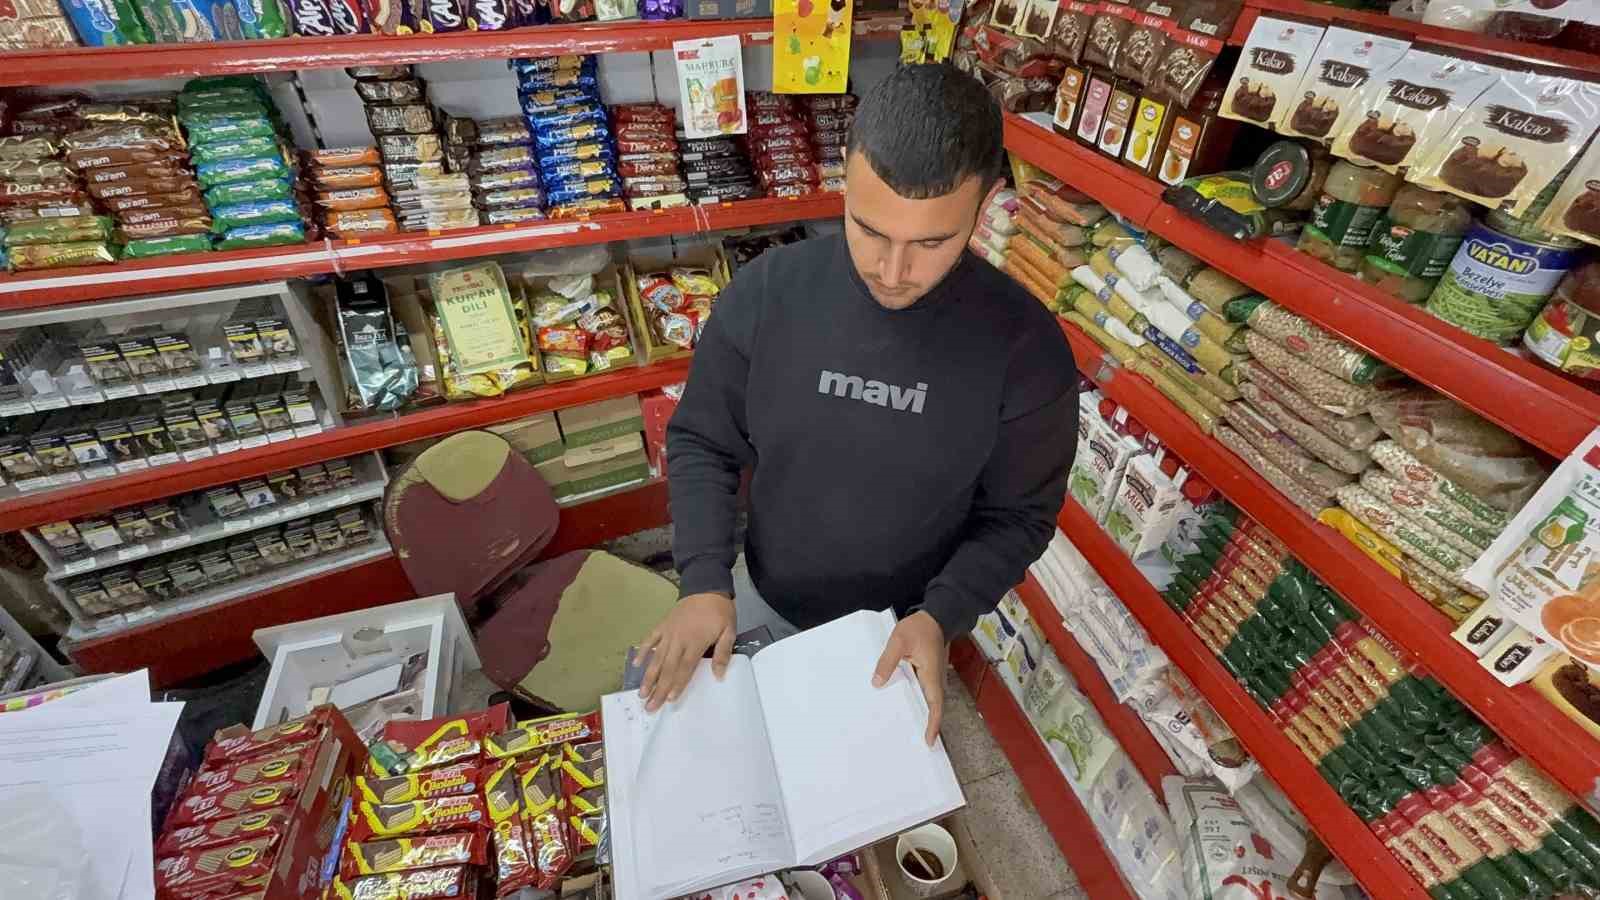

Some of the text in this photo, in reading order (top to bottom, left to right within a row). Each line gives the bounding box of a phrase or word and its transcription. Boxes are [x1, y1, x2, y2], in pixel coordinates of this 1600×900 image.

[1255, 51, 1286, 70] Kakao
[1396, 84, 1437, 106] Kakao
[1499, 111, 1552, 137] Kakao
[1469, 242, 1529, 273] VATAN
[1461, 266, 1507, 290] Bezelye
[818, 369, 928, 414] mavi
